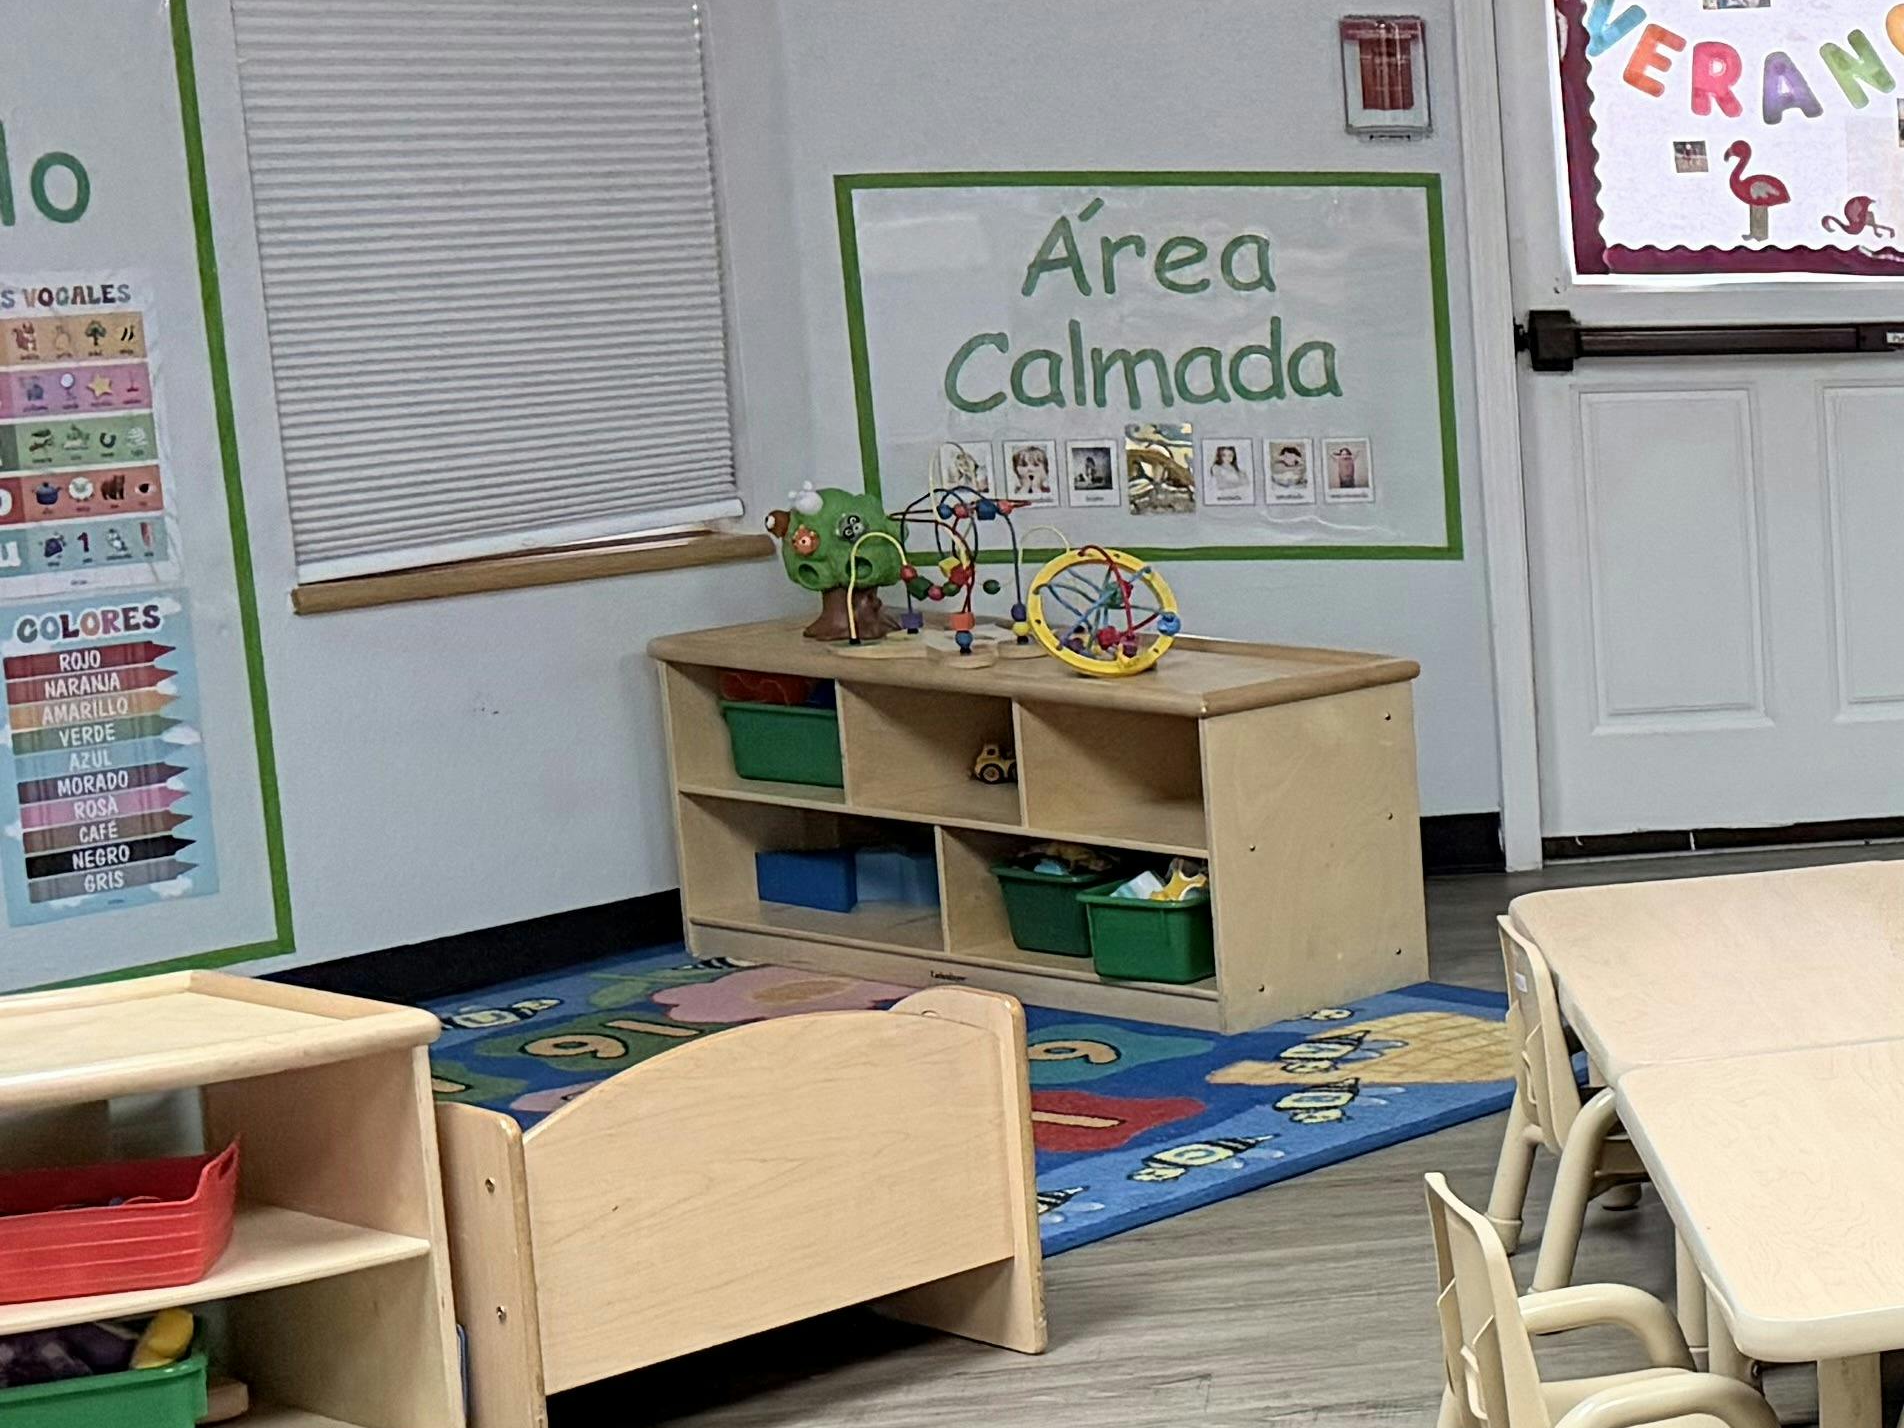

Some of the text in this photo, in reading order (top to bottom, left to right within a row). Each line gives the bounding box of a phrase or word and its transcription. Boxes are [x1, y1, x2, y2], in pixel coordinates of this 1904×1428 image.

[1020, 197, 1277, 297] Área
[22, 283, 132, 308] VOCALES
[943, 316, 1344, 414] Calmada
[16, 604, 162, 643] COLORES
[59, 649, 101, 672] ROJO
[44, 671, 121, 699] NARANJA
[42, 696, 129, 726] AMARILLO
[59, 723, 116, 748] VERDE
[68, 748, 112, 771] AZUL
[57, 770, 129, 797] MORADO
[73, 796, 119, 820] ROSA
[79, 821, 119, 844] CAFÉ
[72, 845, 130, 870] NEGRO
[83, 870, 125, 893] GRIS
